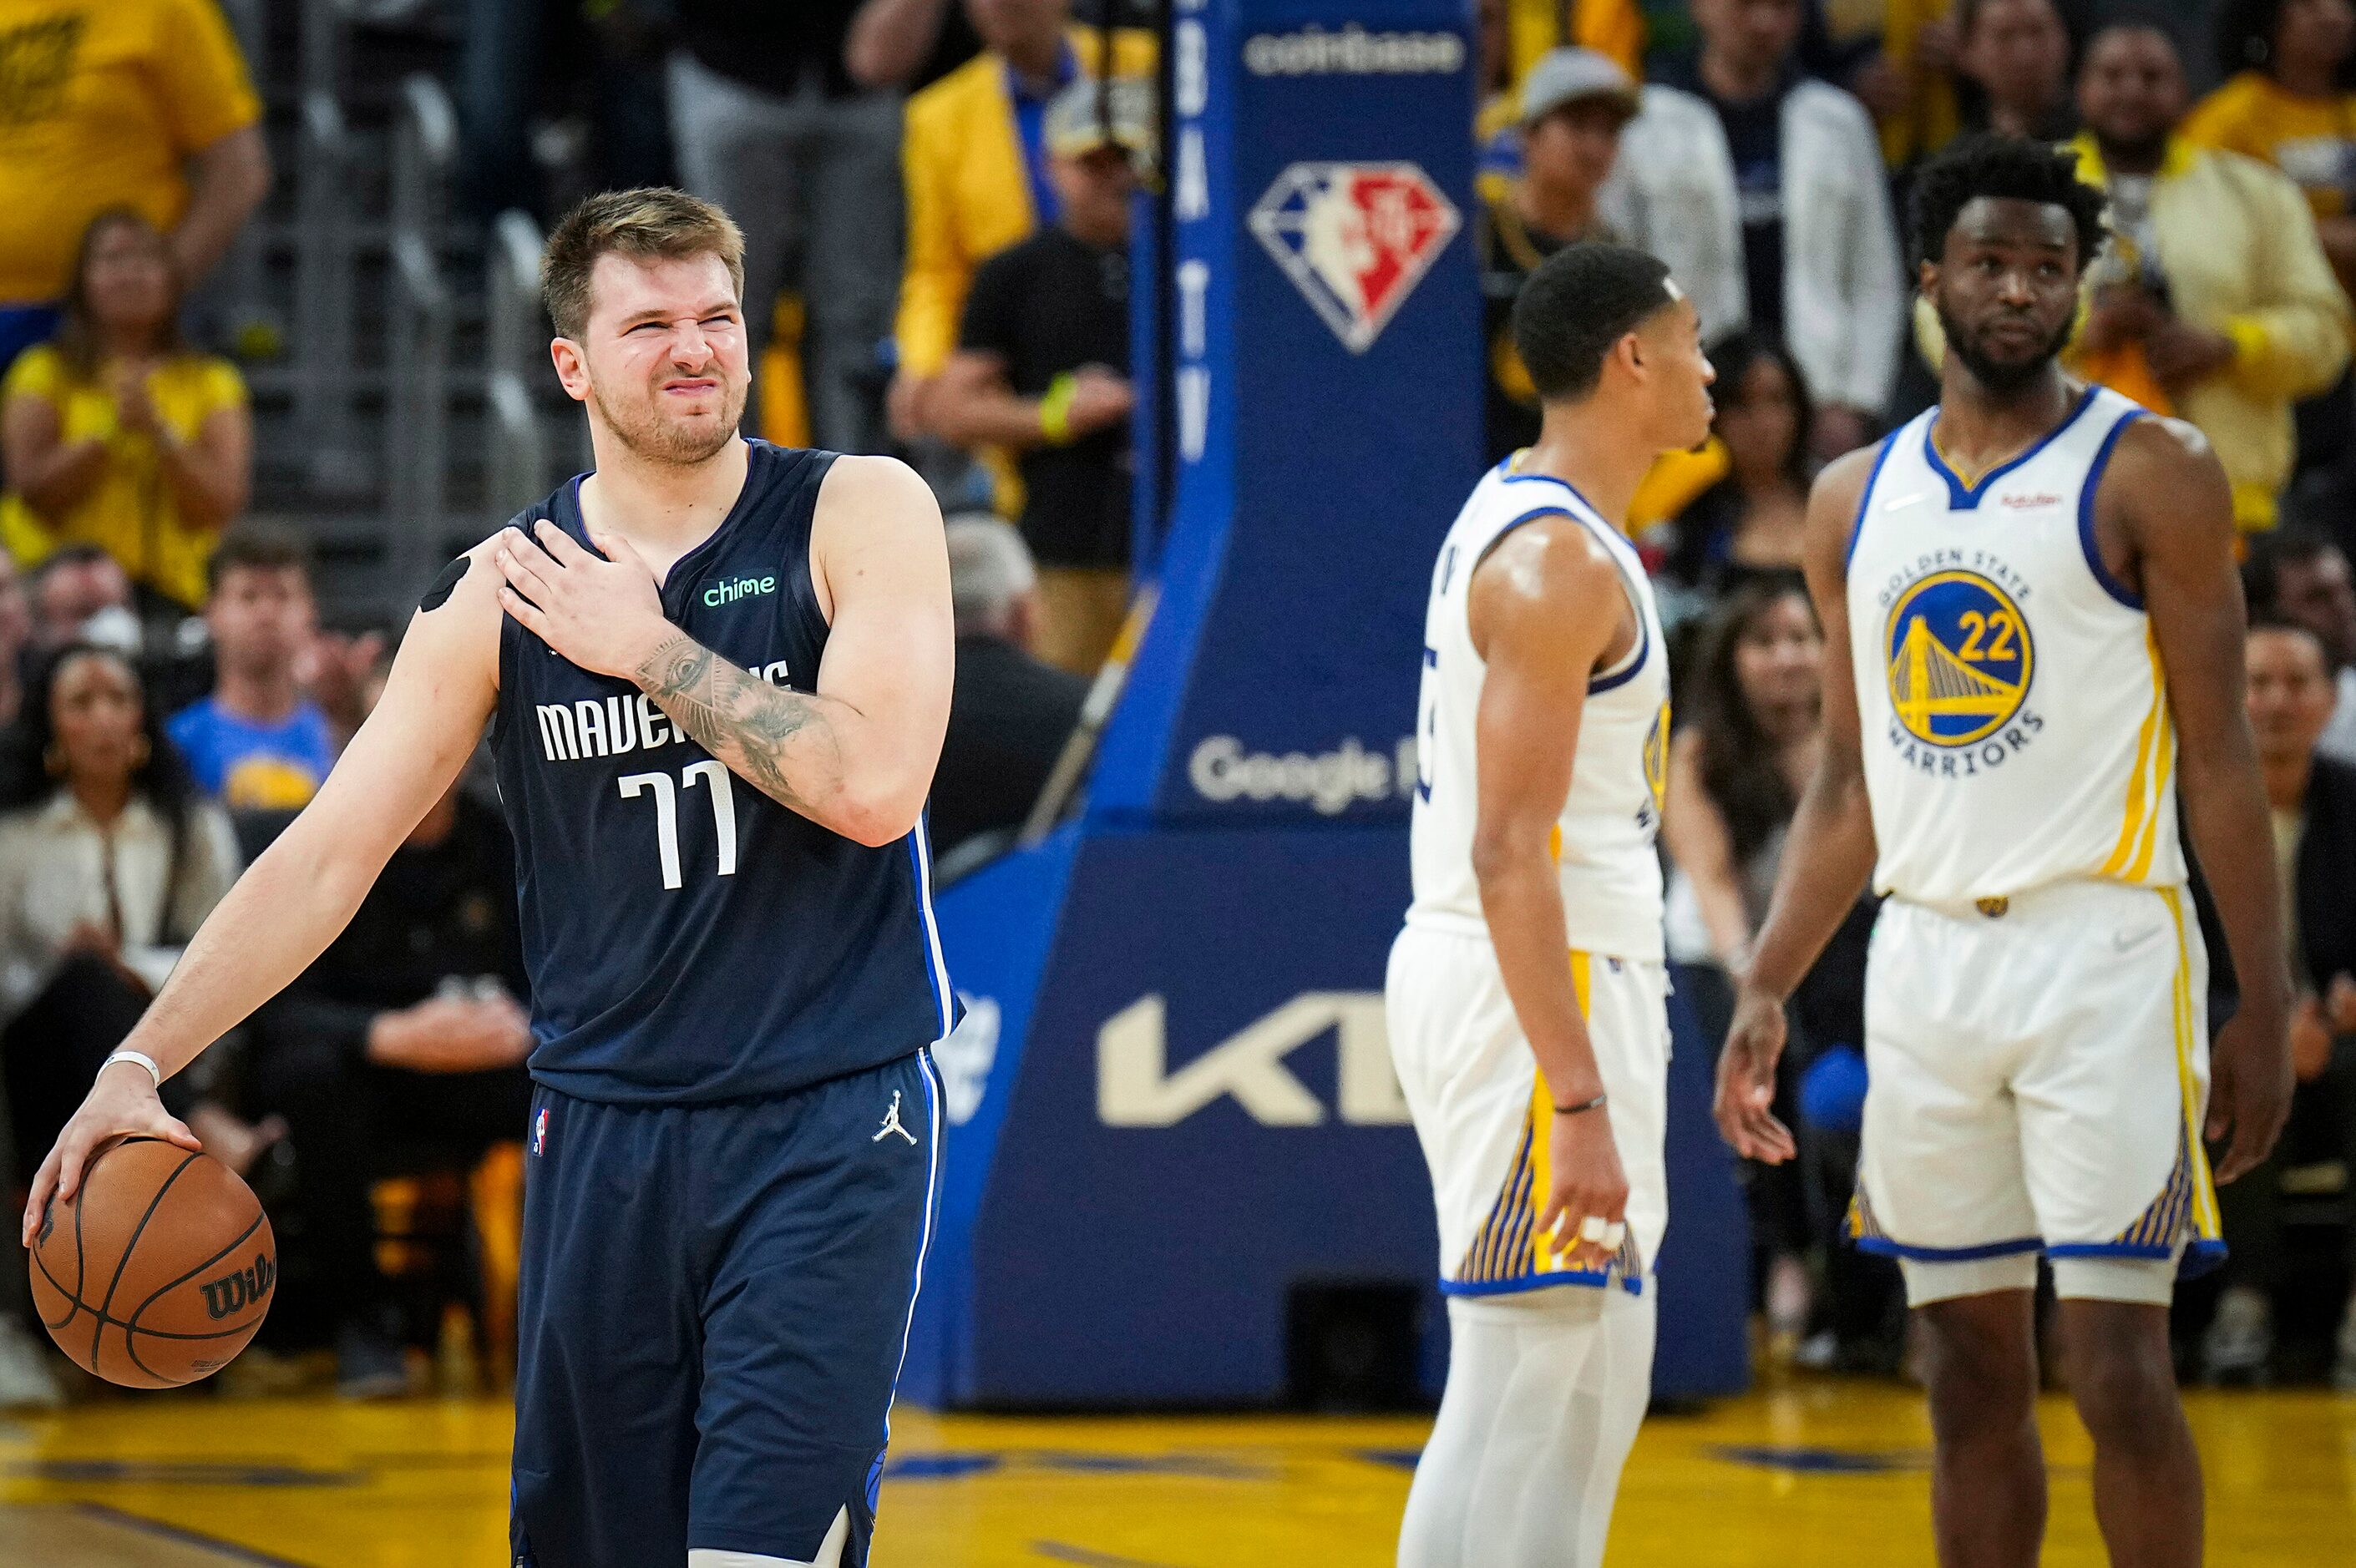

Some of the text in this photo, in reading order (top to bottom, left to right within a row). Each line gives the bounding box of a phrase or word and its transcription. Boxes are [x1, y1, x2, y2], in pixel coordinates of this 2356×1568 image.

[1243, 23, 1465, 75] coinbase
[1175, 0, 1208, 222] BA
[703, 574, 776, 608] chime
[1881, 549, 2031, 608] GOLDEN STATE
[1958, 610, 2017, 661] 22
[1191, 736, 1389, 815] Google
[1888, 711, 2044, 778] WARRIORS
[618, 760, 737, 890] 77
